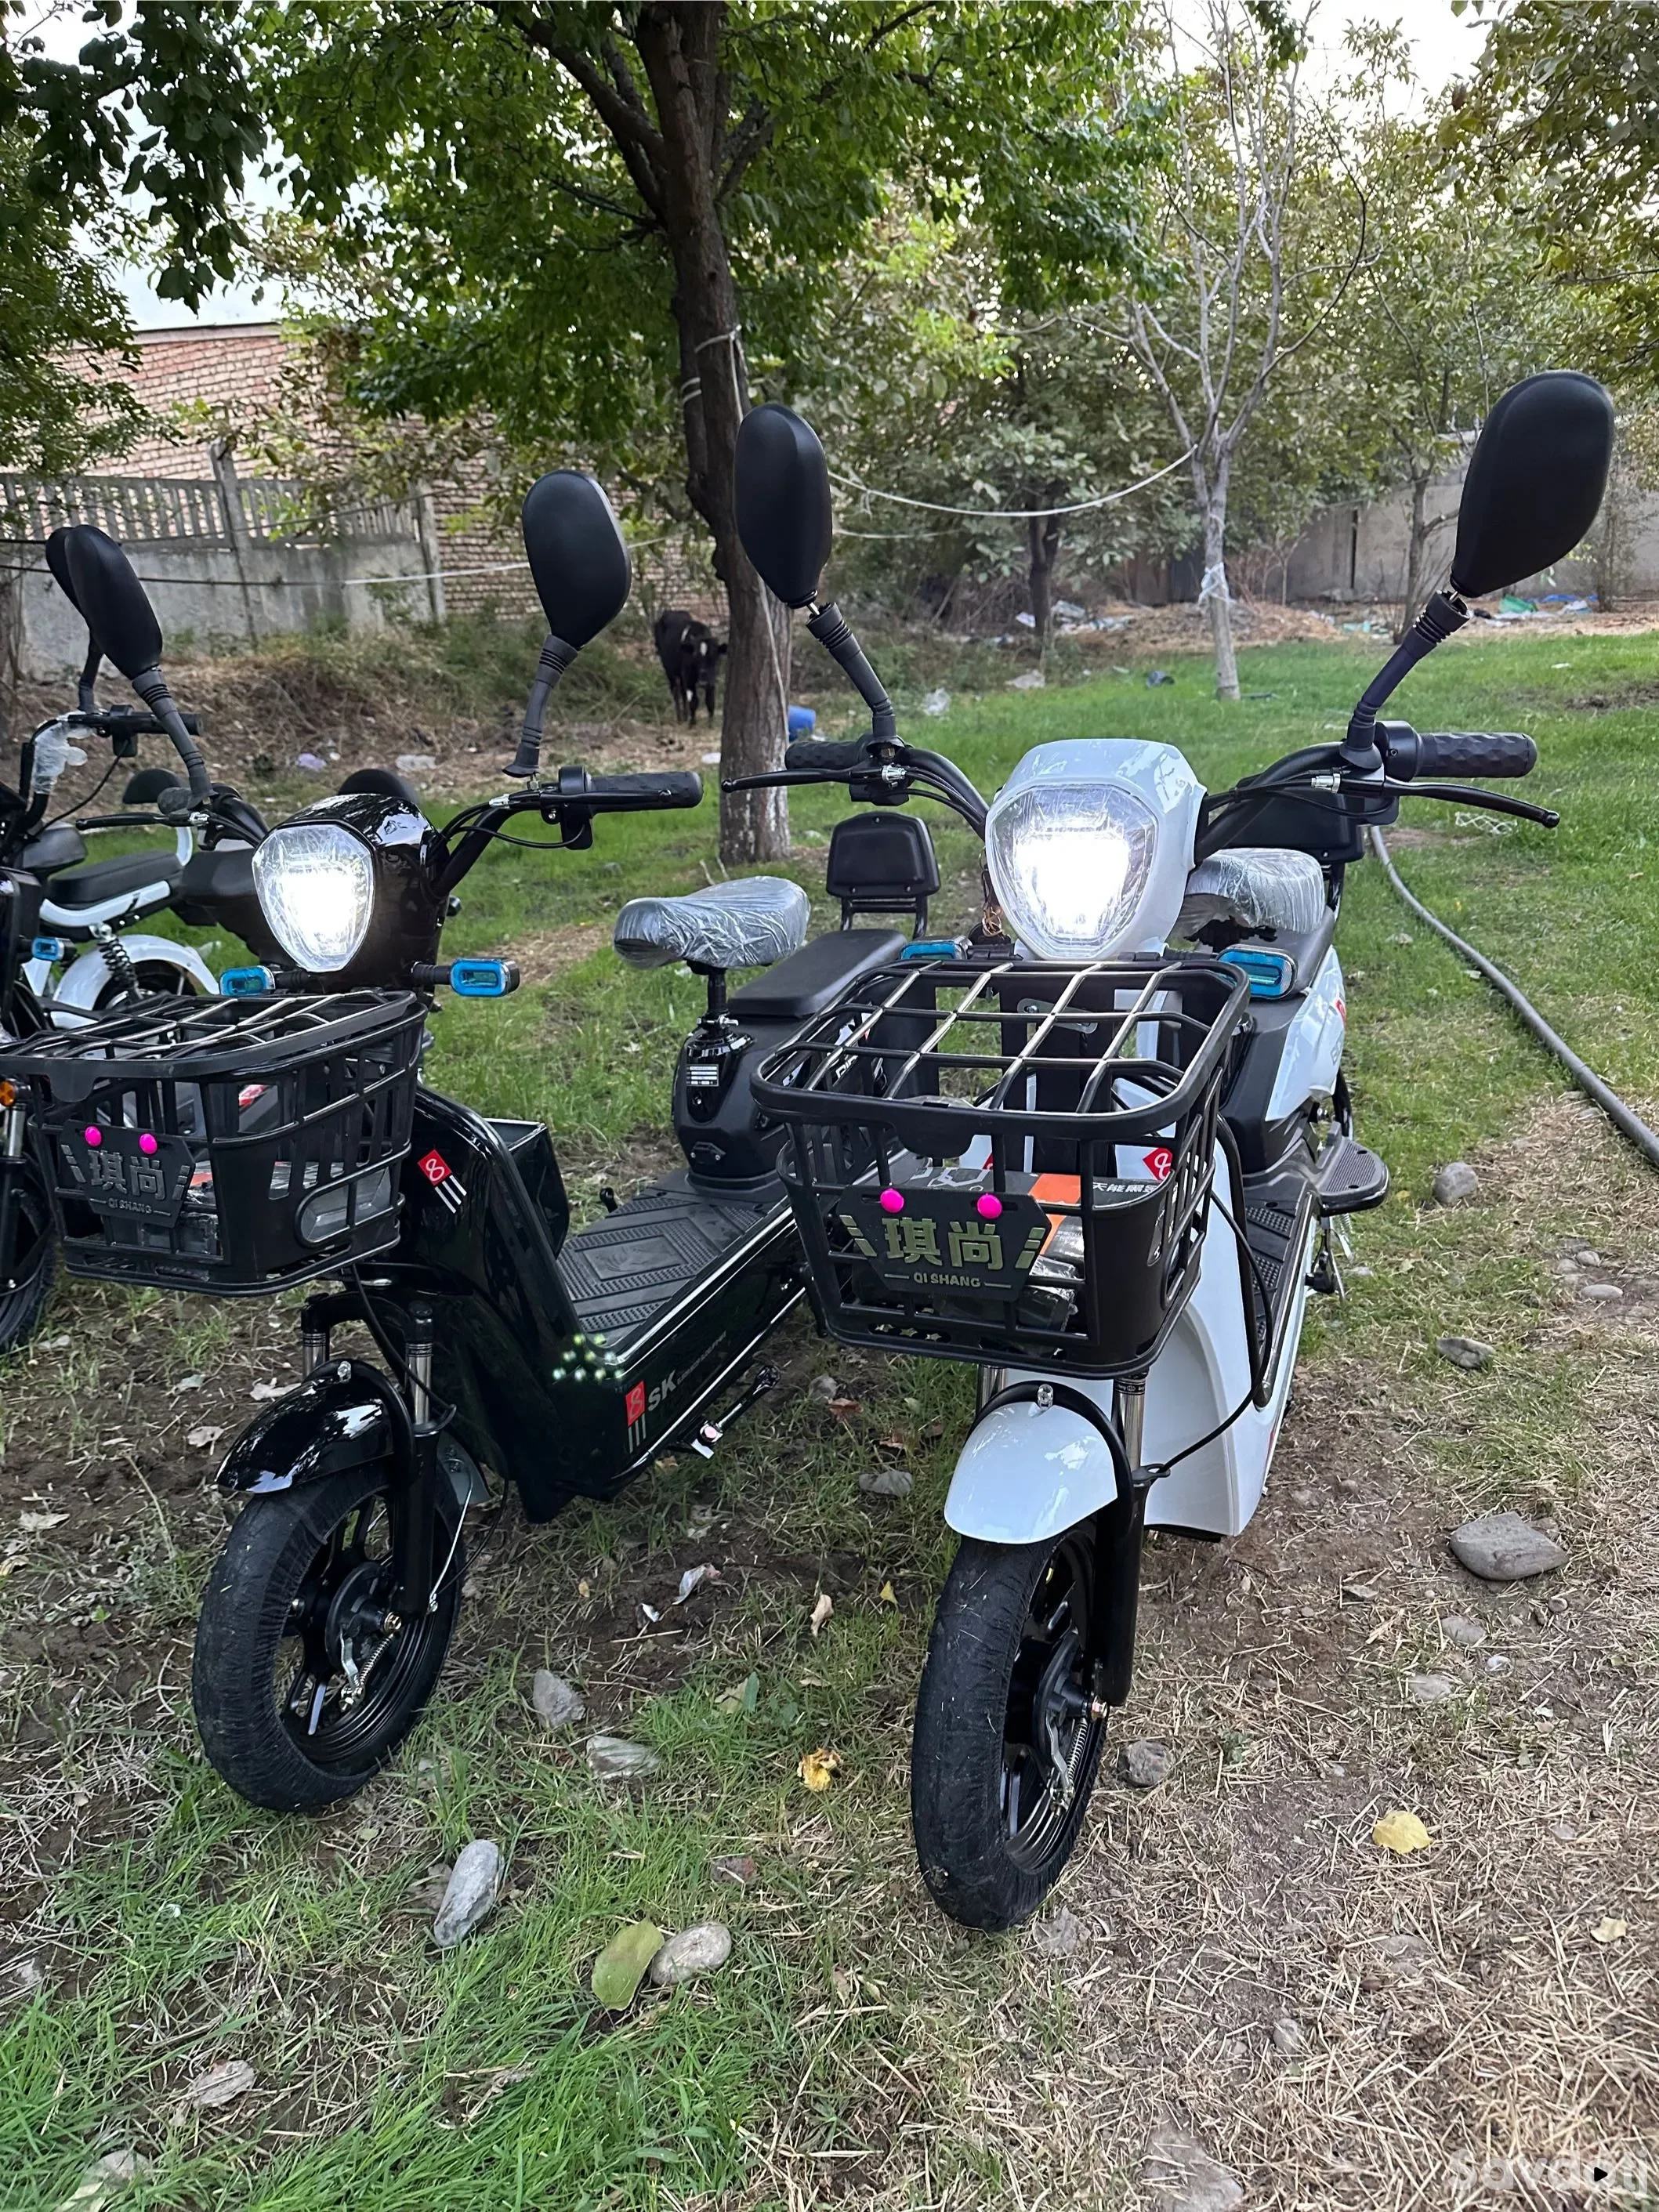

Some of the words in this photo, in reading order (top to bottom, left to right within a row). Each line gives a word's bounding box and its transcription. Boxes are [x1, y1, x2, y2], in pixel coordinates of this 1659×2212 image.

[88, 1149, 166, 1200] 琪尚
[107, 1197, 118, 1208] QI
[118, 1199, 153, 1214] SHANG
[881, 1216, 1003, 1270] 琪尚
[913, 1272, 929, 1284] QI
[930, 1273, 981, 1289] SHANG
[648, 1370, 676, 1410] SK
